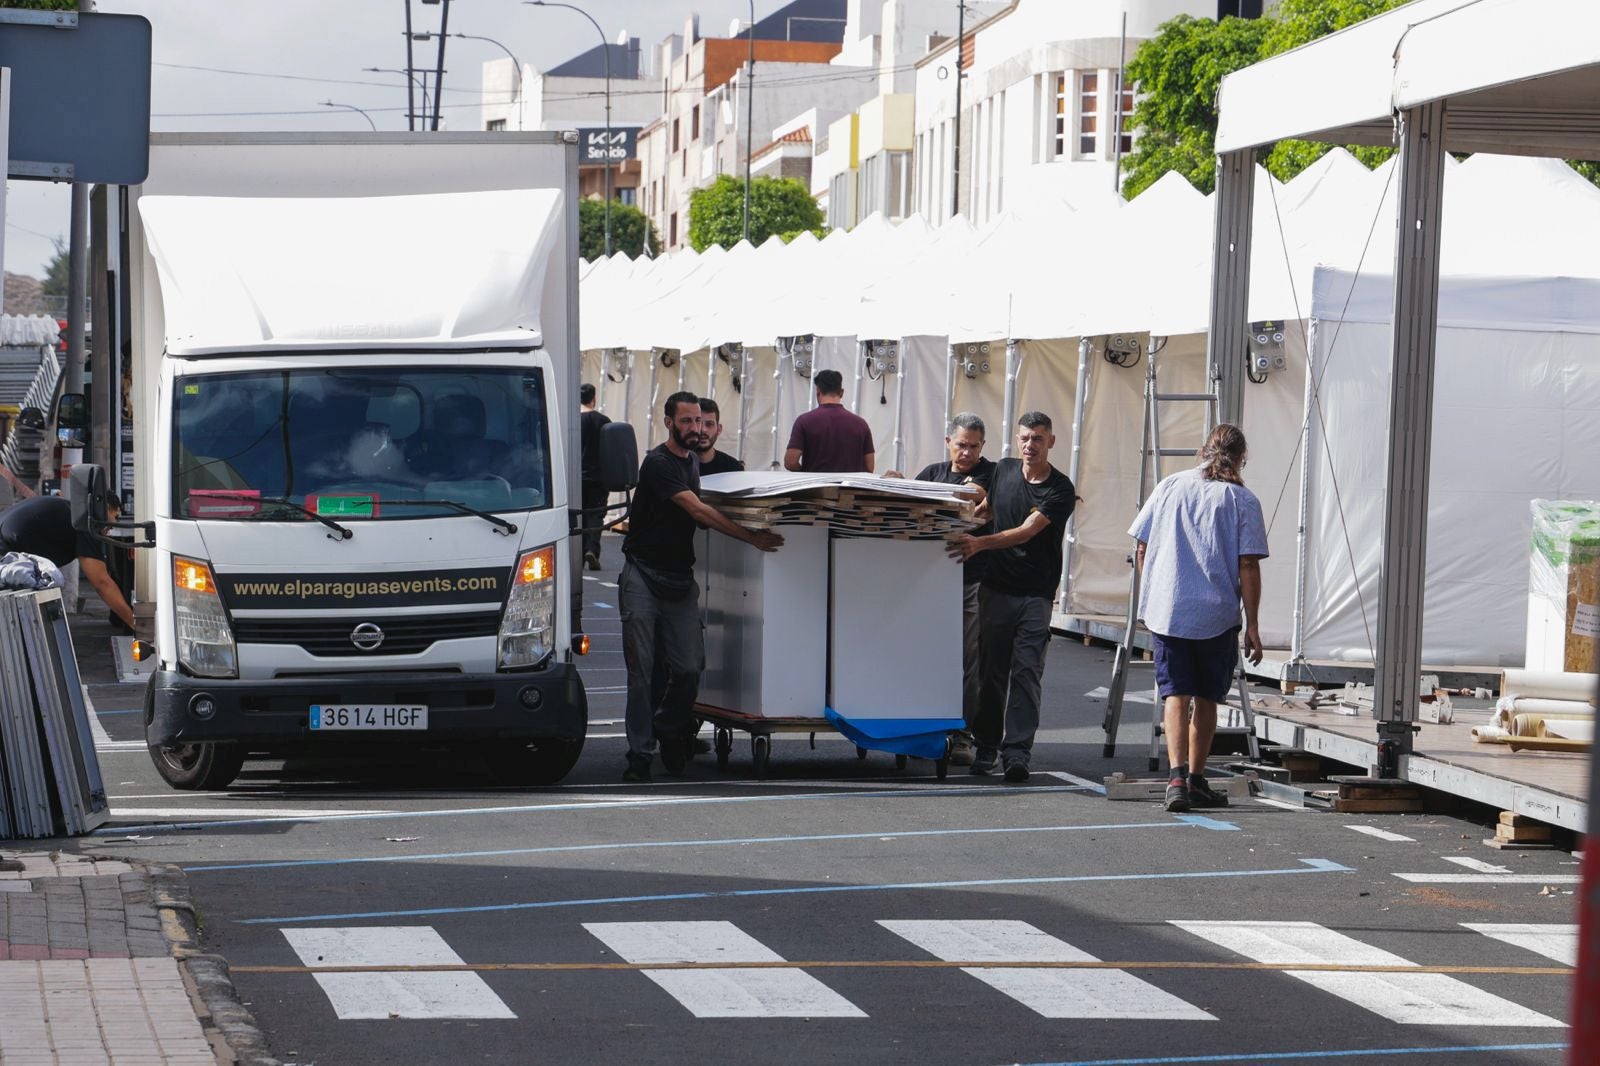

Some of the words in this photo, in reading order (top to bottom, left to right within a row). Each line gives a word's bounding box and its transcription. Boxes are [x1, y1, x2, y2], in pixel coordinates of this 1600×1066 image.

[233, 576, 498, 599] www.elparaguasevents.com
[324, 707, 376, 726] 3614
[383, 707, 422, 726] HGF
